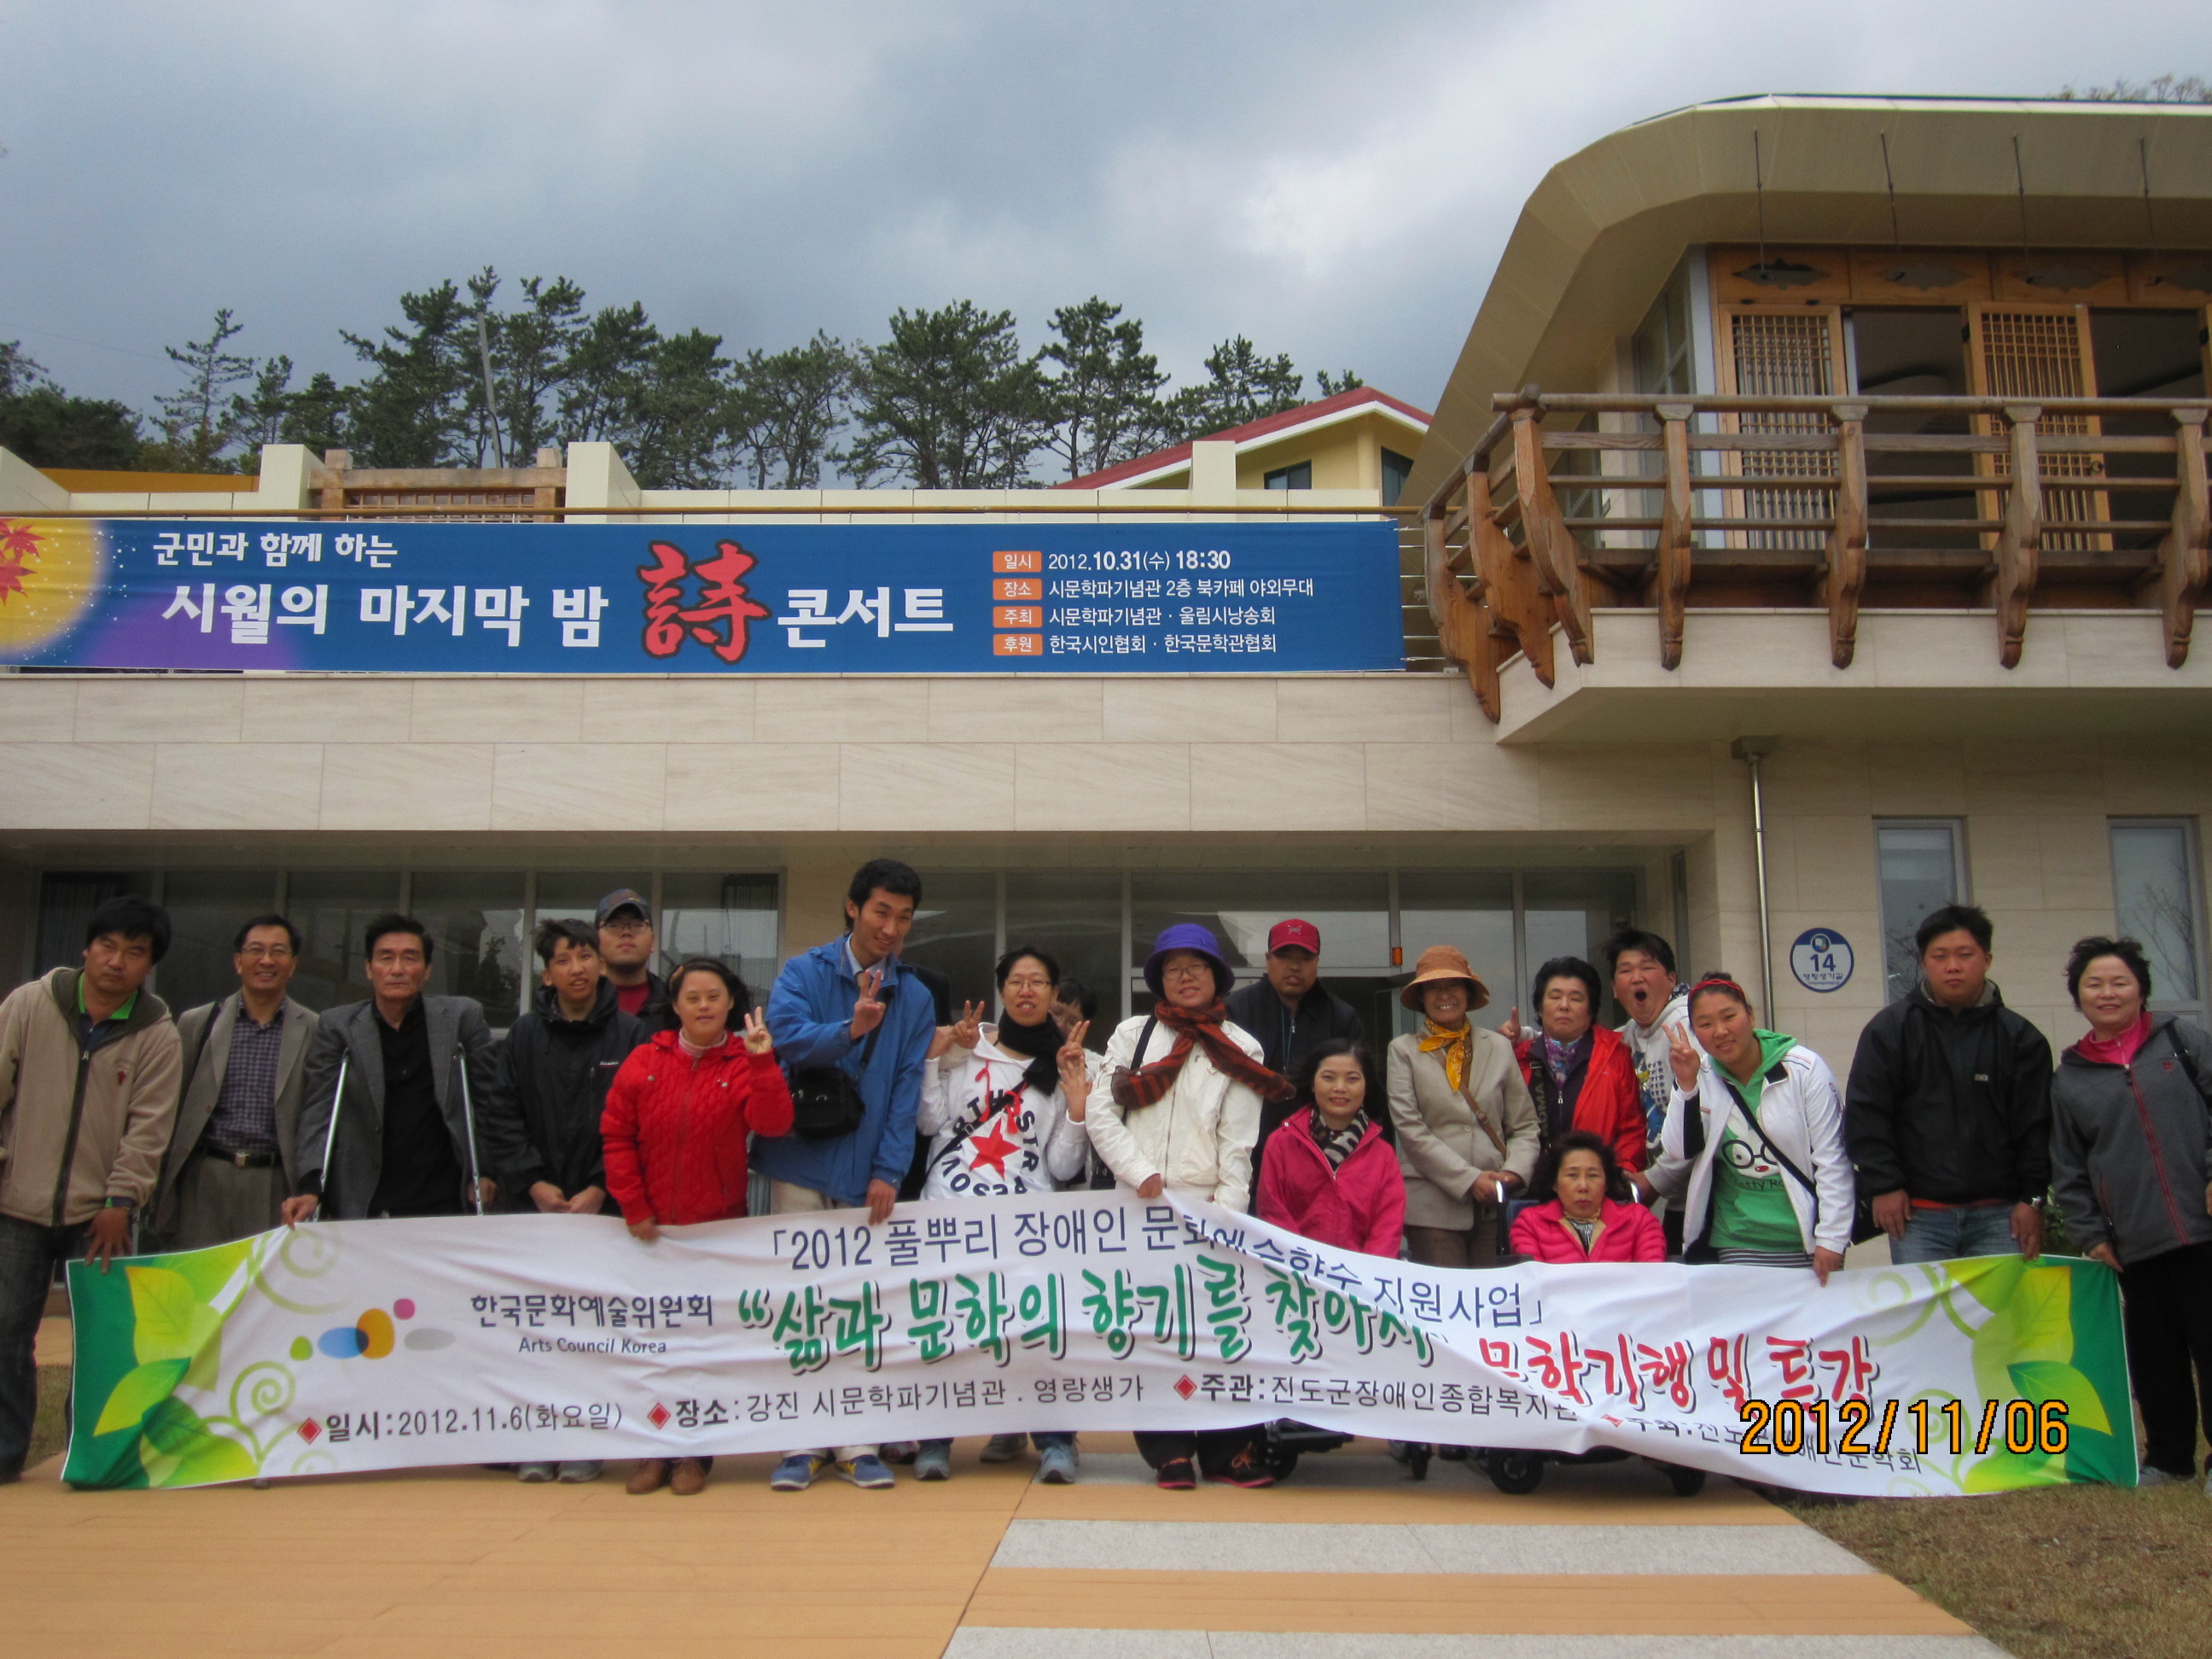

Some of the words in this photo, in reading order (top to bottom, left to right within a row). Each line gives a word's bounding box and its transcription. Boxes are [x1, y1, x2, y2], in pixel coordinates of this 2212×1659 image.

[154, 533, 248, 566] 군민과
[260, 533, 322, 567] 함께
[335, 534, 397, 568] 하는
[1004, 554, 1031, 568] 일시
[1049, 551, 1169, 571] 2012.10.31(수)
[1177, 550, 1230, 568] 18:30
[1004, 582, 1031, 597] 장소
[1050, 579, 1161, 598] 시문학파기념관
[1167, 579, 1191, 597] 2층
[1197, 579, 1243, 597] 북카페
[1250, 579, 1313, 597] 야외무대
[162, 584, 328, 643] 시월의
[360, 585, 529, 646] 마지막
[553, 587, 608, 647] 밤
[778, 587, 953, 647] 콘서트
[1004, 609, 1031, 624] 주최
[1050, 608, 1161, 626] 시문학파기념관
[1179, 607, 1274, 625] 울림시낭송회
[1004, 637, 1031, 652] 후원
[1050, 635, 1145, 654] 한국시인협회
[1165, 634, 1276, 652] 한국문학관협회
[1810, 953, 1837, 973] 14
[883, 1214, 998, 1267] 풀뿌리
[1013, 1205, 1128, 1257] 장애인
[470, 1294, 714, 1330] 한국문화예술위원회
[905, 1270, 1067, 1365] 문학의
[1080, 1261, 1253, 1364] 향기를
[520, 1337, 551, 1352] Arts
[557, 1338, 614, 1353] Council
[622, 1338, 666, 1353] Korea
[813, 1380, 1005, 1417] 시문학파기념관
[1035, 1375, 1143, 1403] 영랑생가
